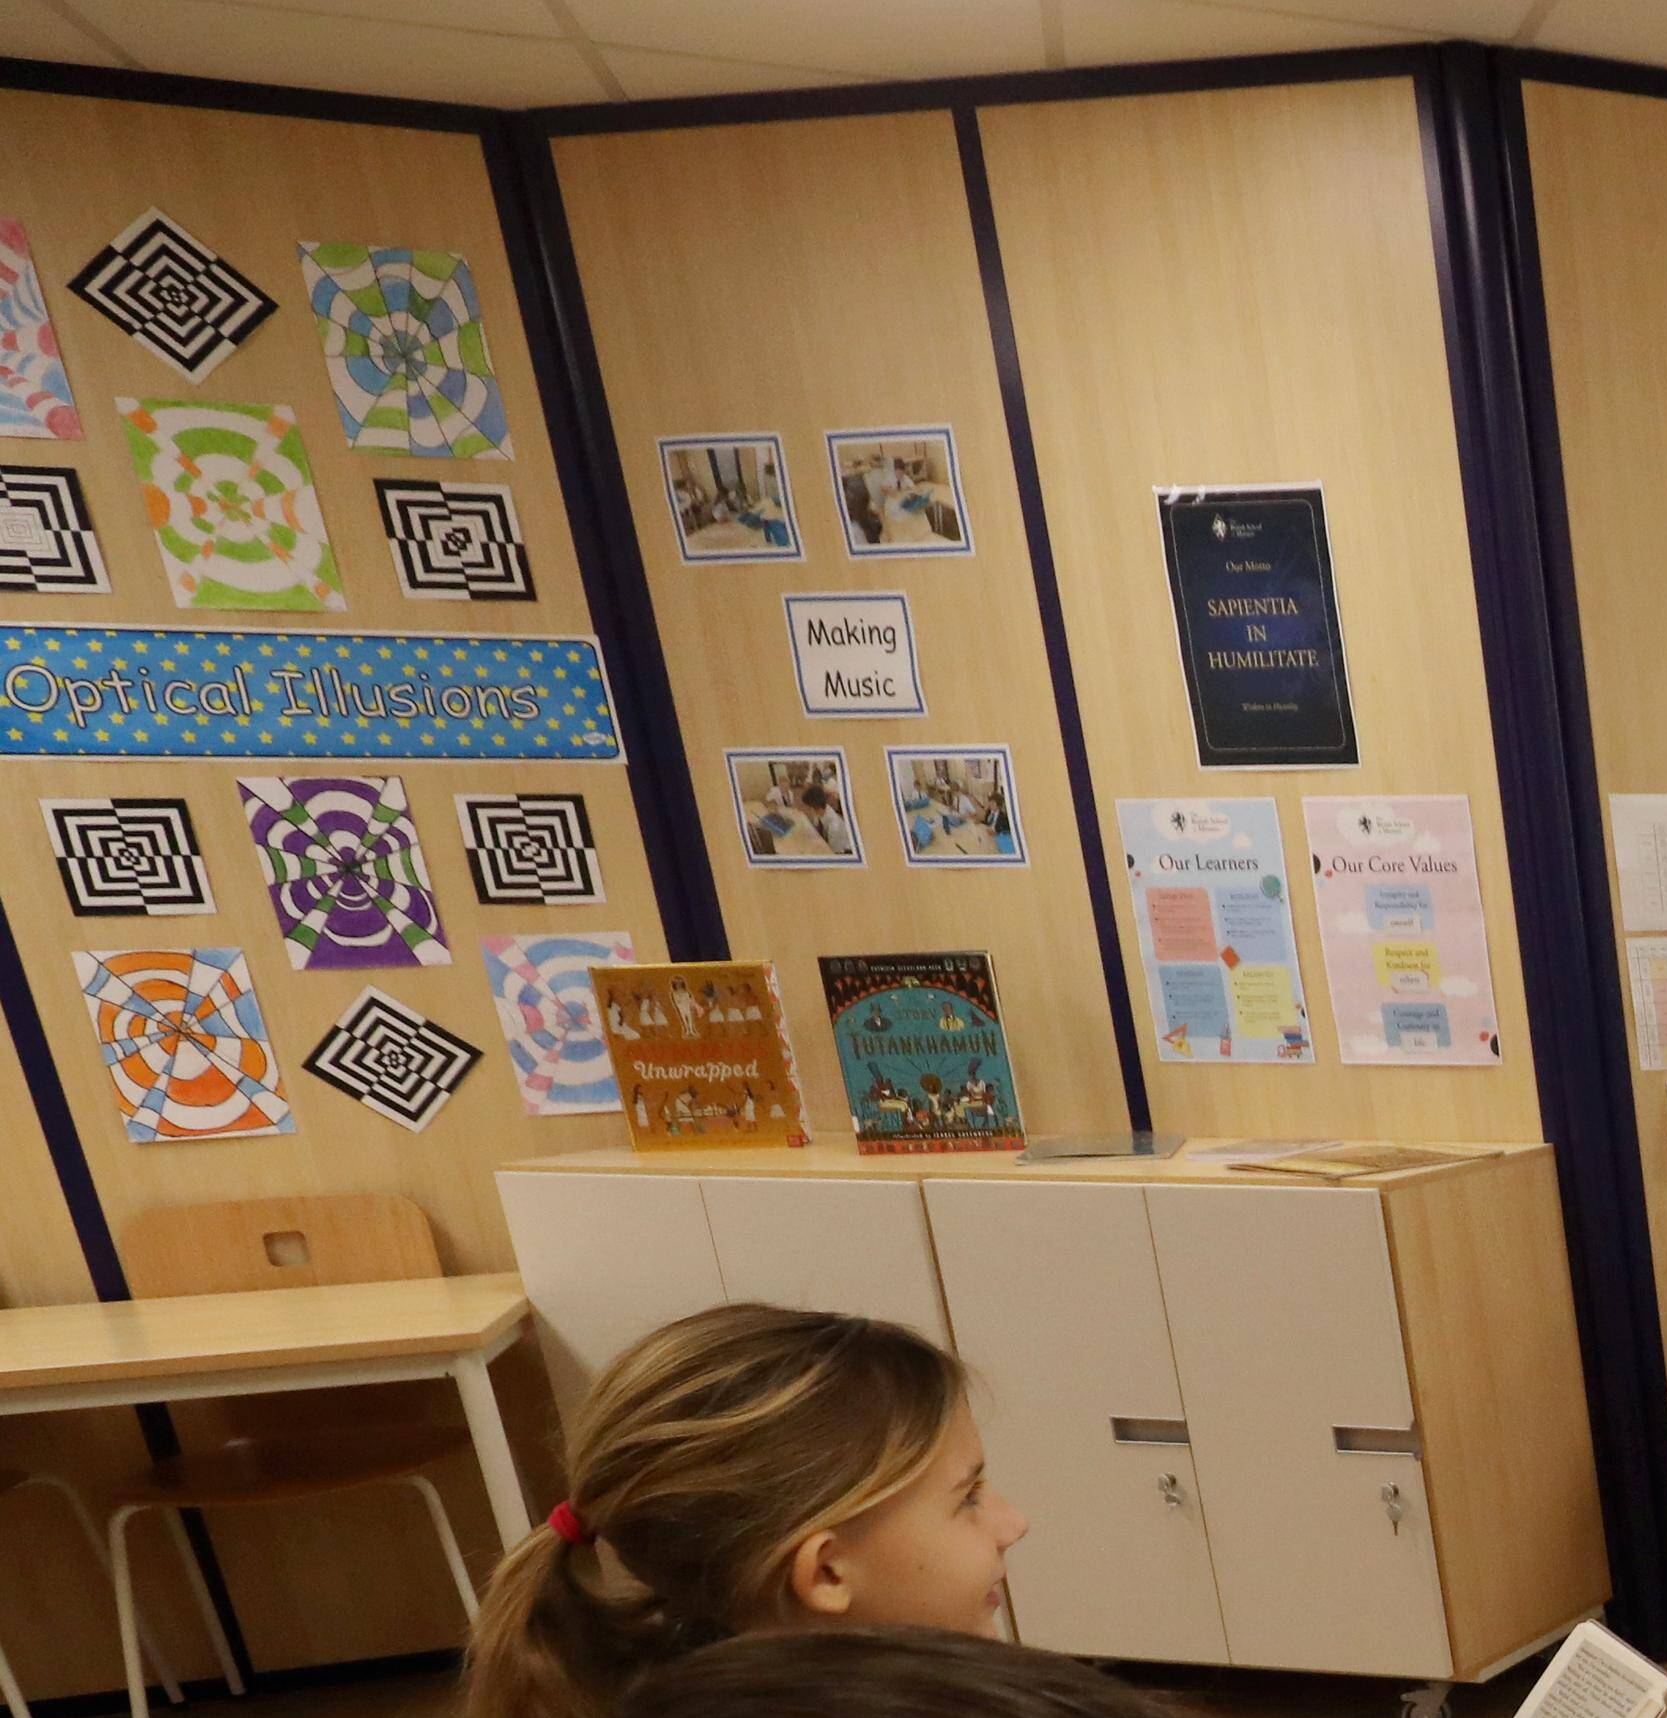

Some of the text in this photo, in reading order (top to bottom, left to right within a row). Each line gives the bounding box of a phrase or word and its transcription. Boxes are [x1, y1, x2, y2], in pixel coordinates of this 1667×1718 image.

[1207, 598, 1299, 617] SAPIENTIA
[806, 617, 898, 655] Making
[1246, 625, 1268, 643] IN
[1208, 648, 1320, 669] HUMILITATE
[4, 661, 542, 730] Optical Illusions
[824, 670, 897, 699] Music
[1158, 853, 1260, 873] Our Learners
[1331, 855, 1458, 874] Our Core Values
[851, 1029, 998, 1061] TUTANKHAMUN
[632, 1058, 761, 1084] Unwrapped
